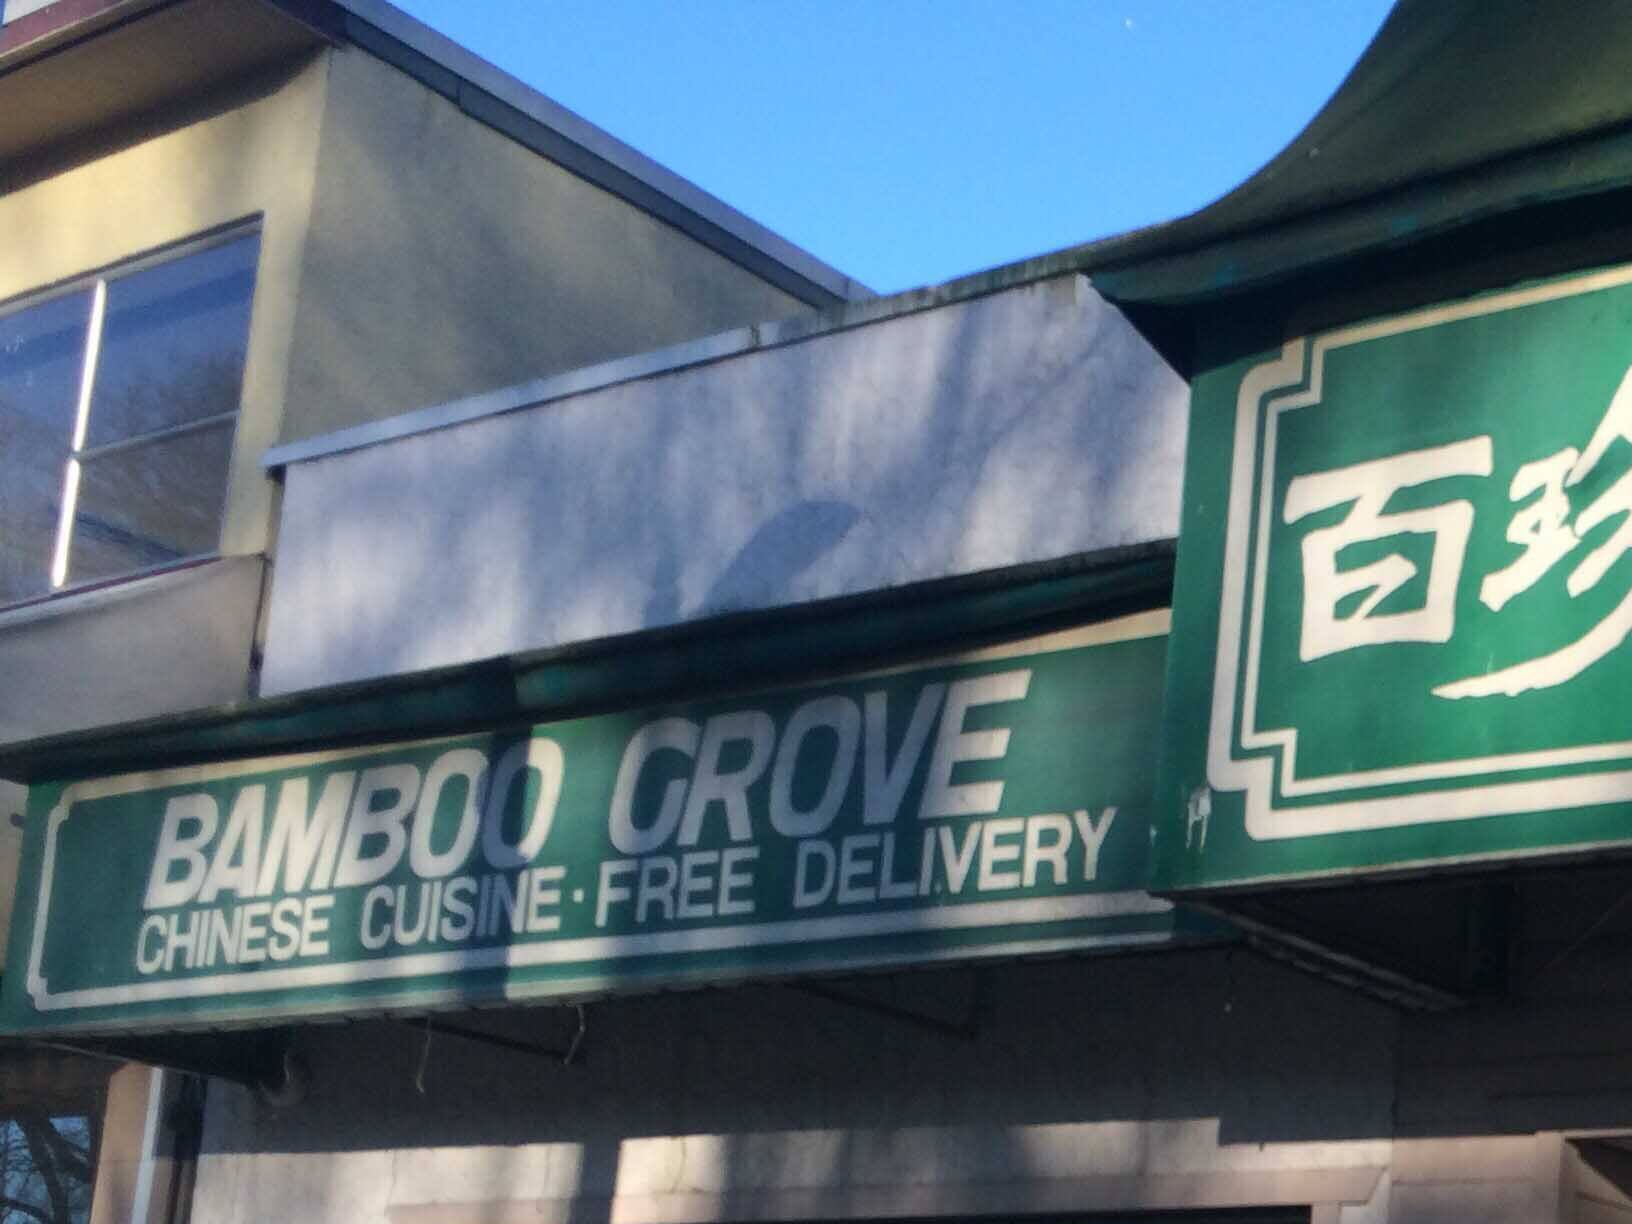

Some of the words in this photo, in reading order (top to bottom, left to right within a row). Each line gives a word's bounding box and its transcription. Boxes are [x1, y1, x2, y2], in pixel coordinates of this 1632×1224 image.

[136, 895, 335, 974] CHINESE
[360, 865, 567, 950] CUISINE
[595, 846, 761, 928] FREE
[792, 806, 1118, 909] DELIVERY
[143, 736, 564, 910] BAMBOO
[608, 669, 1032, 855] GROVE
